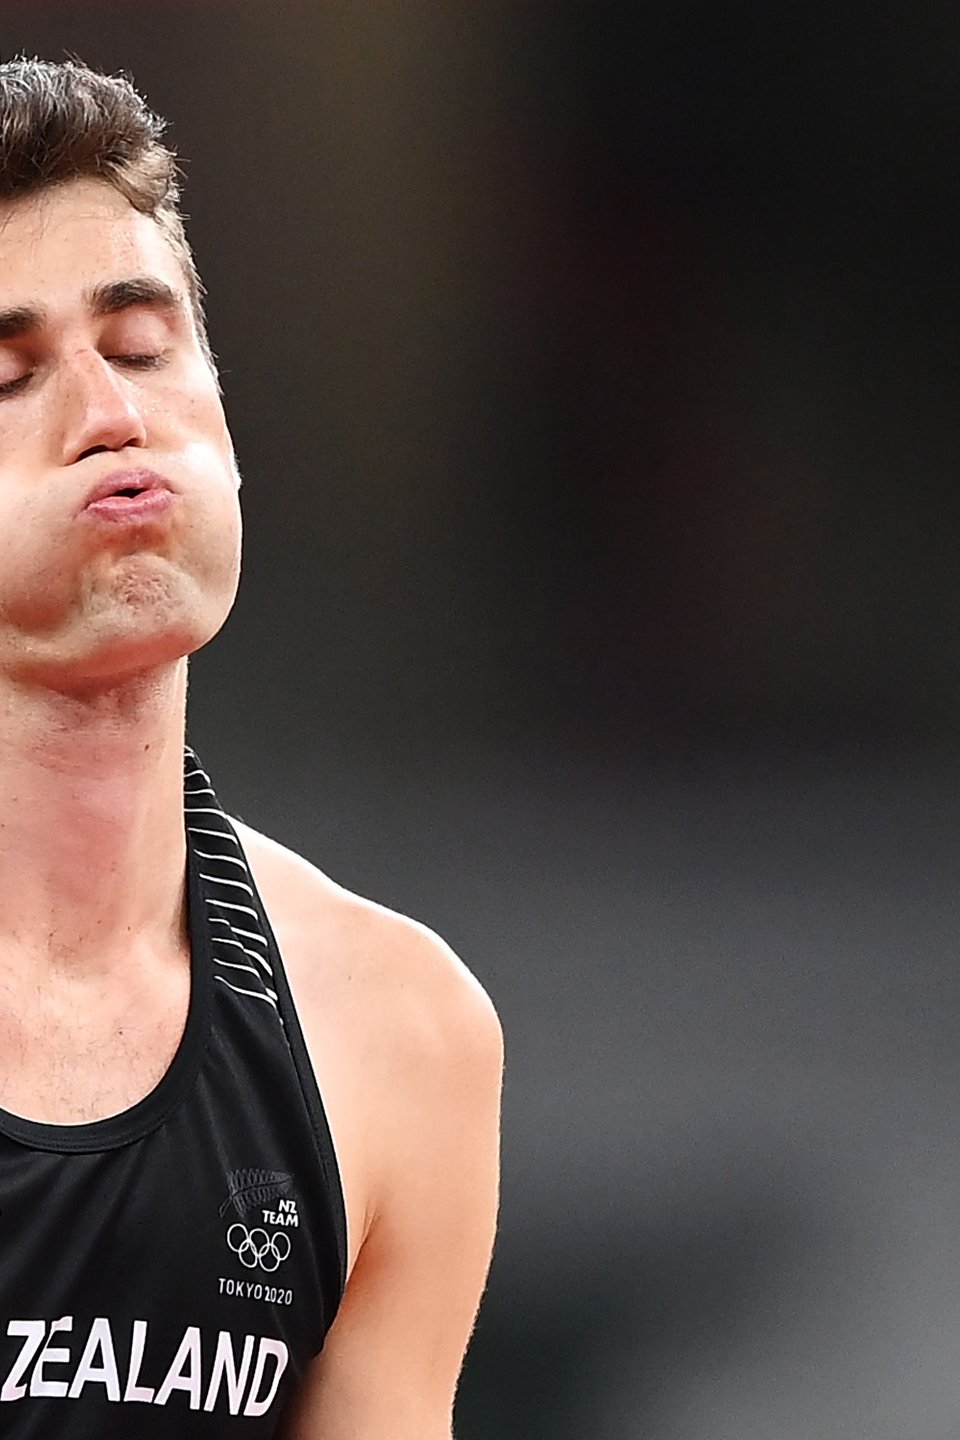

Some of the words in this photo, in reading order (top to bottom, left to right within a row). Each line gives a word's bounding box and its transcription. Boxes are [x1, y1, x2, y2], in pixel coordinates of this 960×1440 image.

[278, 1199, 298, 1214] NZ
[261, 1209, 299, 1228] TEAM
[218, 1277, 263, 1300] TOKYO
[264, 1286, 293, 1305] 2020
[0, 1315, 289, 1417] ZEALAND
